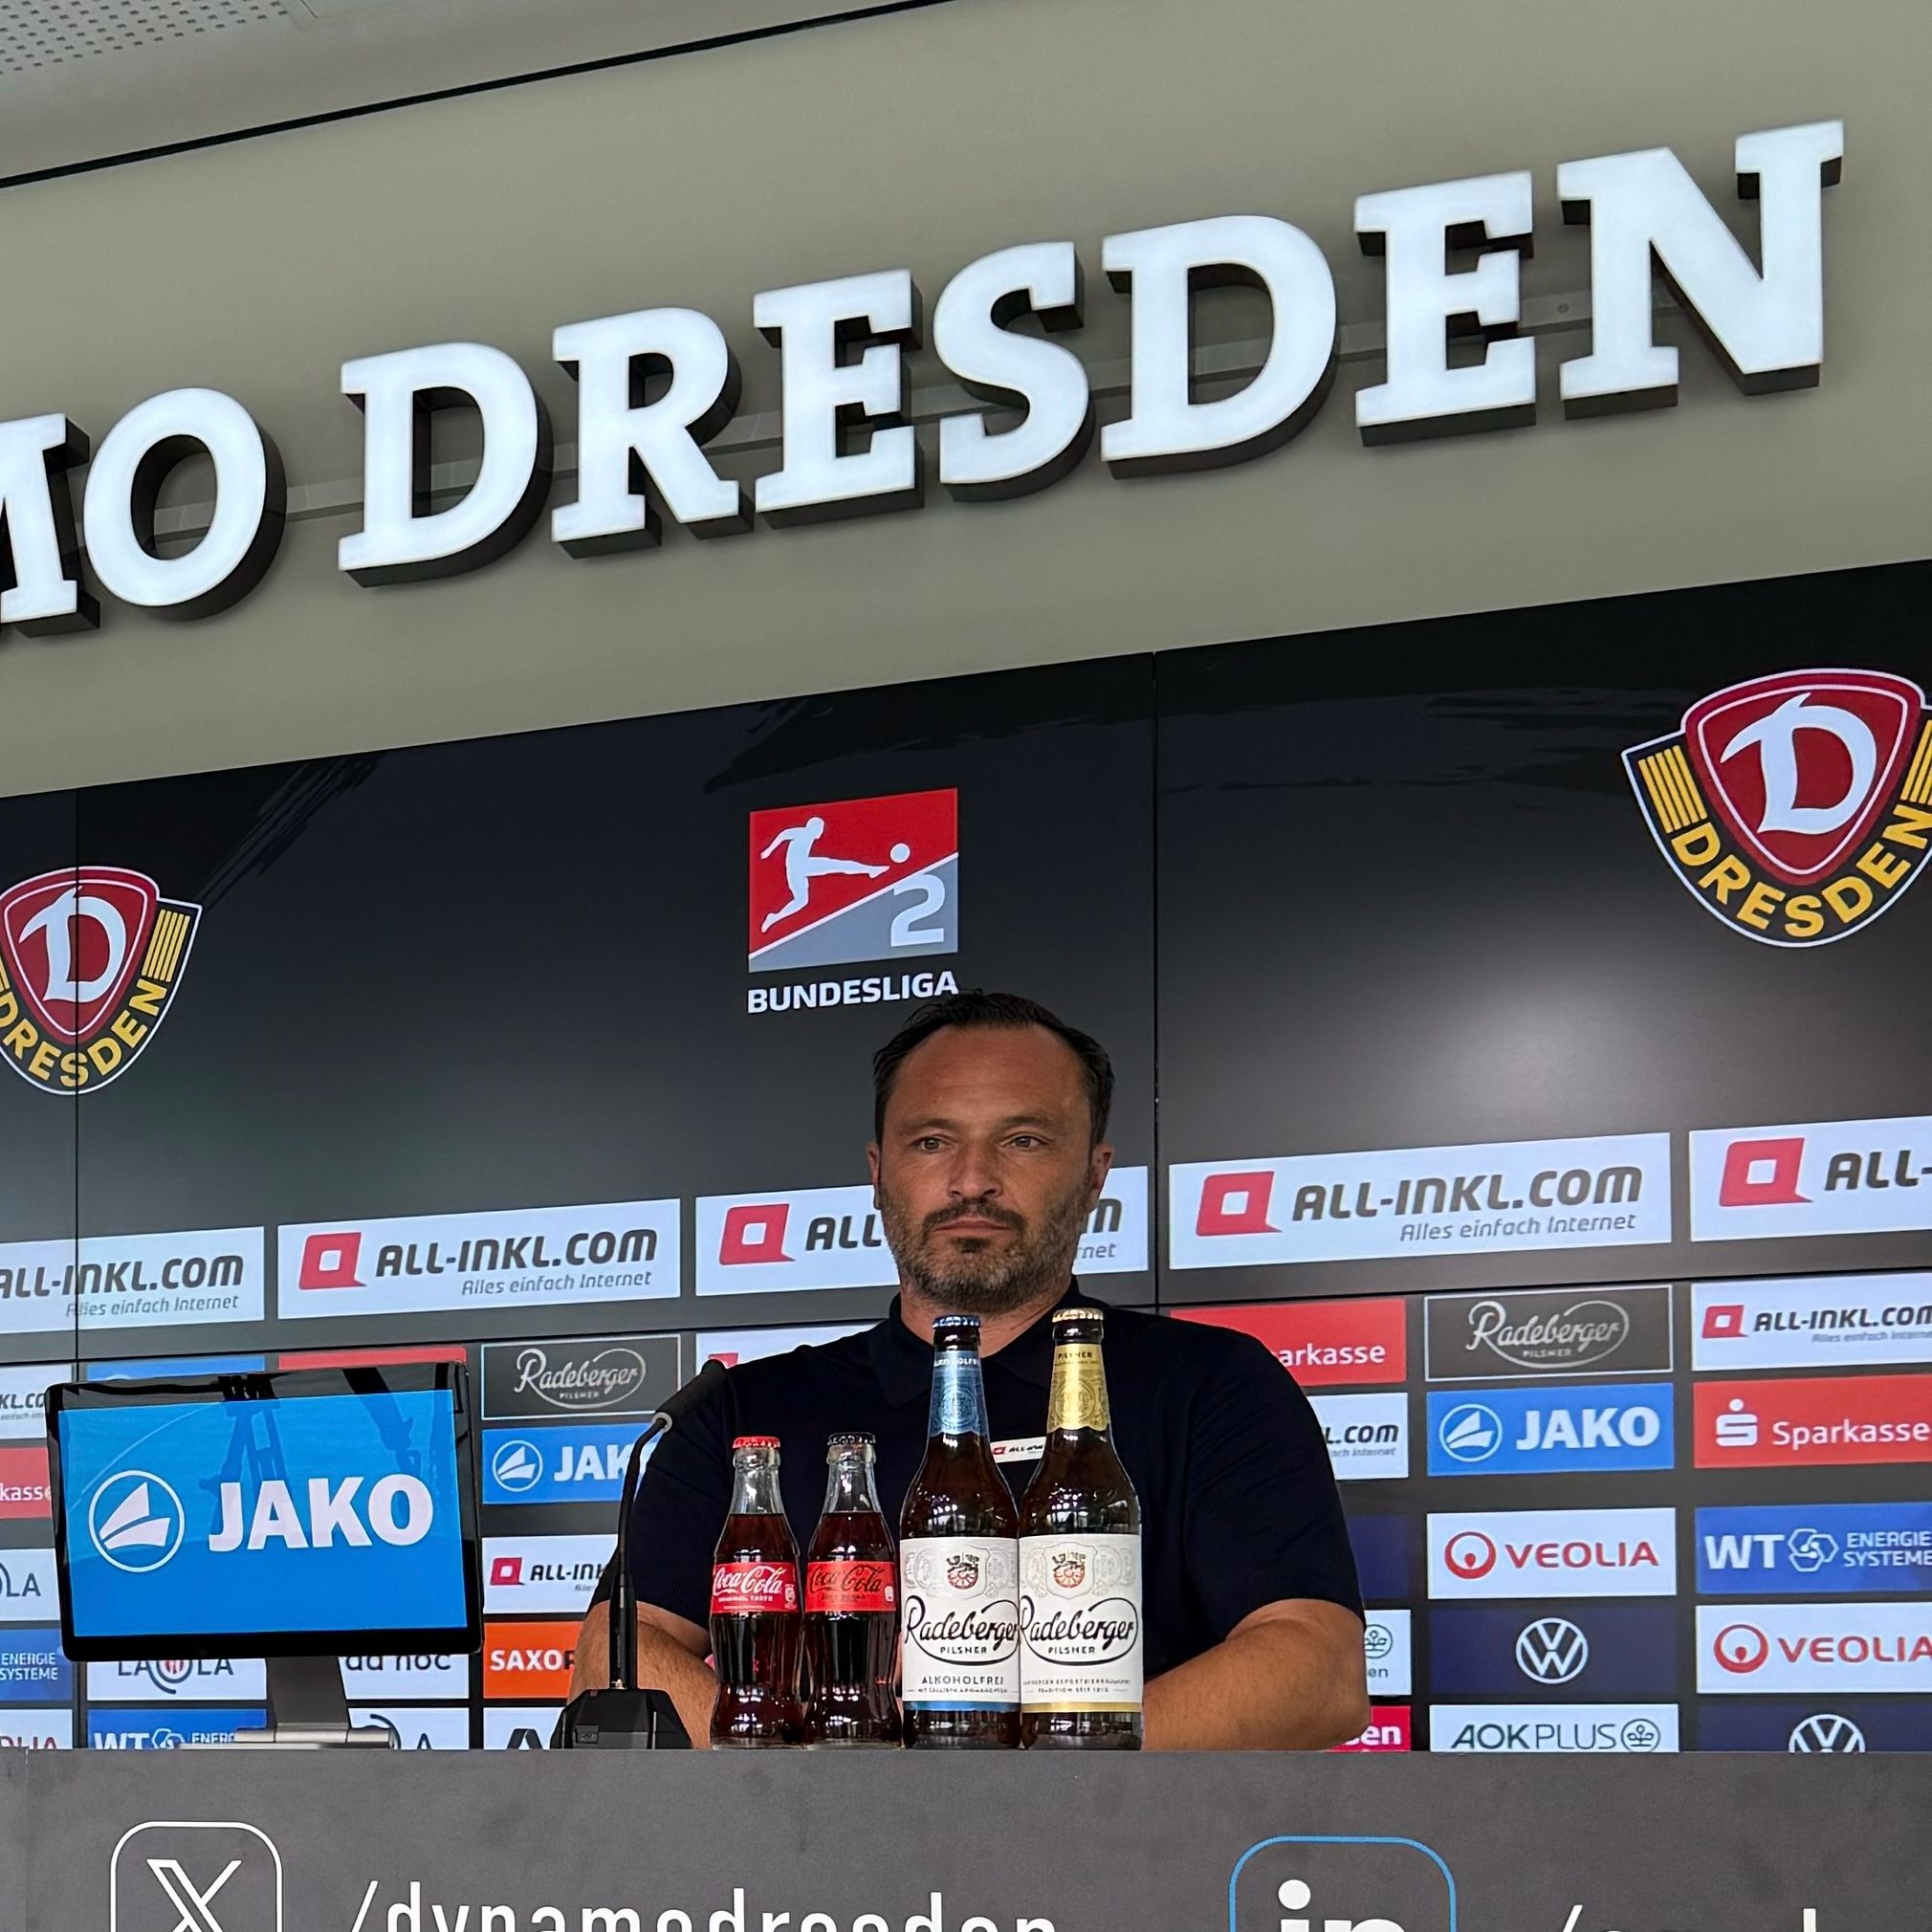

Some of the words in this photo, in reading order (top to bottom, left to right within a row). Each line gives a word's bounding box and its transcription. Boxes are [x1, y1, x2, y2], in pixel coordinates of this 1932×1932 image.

[338, 121, 1844, 572] DRESDEN
[1670, 804, 1932, 938] DRESDEN
[890, 873, 946, 948] 2
[747, 970, 959, 1015] BUNDESLIGA
[1291, 1165, 1643, 1222] ALL-INKL.COM
[1400, 1223, 1453, 1242] Alles
[1460, 1217, 1540, 1240] einfach
[1546, 1214, 1636, 1235] Internet
[374, 1228, 658, 1278] ALL-INKL.COM
[461, 1280, 505, 1297] Alles
[509, 1275, 575, 1294] einfach
[579, 1271, 652, 1288] Internet
[111, 1296, 170, 1315] einfach
[174, 1295, 239, 1312] Internet
[1466, 1301, 1622, 1353] Radeberger
[1279, 1343, 1386, 1368] arkasse
[515, 1349, 641, 1395] Radeberger
[1516, 1406, 1660, 1451] JAKO
[1772, 1418, 1930, 1451] Sparkasse
[209, 1473, 433, 1552] JAKO
[1504, 1541, 1659, 1569] VEOLIA
[1704, 1533, 1785, 1570] WT
[1847, 1530, 1932, 1548] ENERGIE
[1843, 1550, 1932, 1568] SYSTEME
[905, 1594, 1019, 1652] Radeberger
[1, 1652, 55, 1665] ENERGIE
[940, 1645, 988, 1655] PILSNER
[1048, 1645, 1096, 1655] PILSNER
[1777, 1636, 1932, 1663] VEOLIA
[0, 1666, 58, 1680] SYSTEME
[921, 1675, 1004, 1685] ALKOHOLFREI
[1346, 1725, 1401, 1745] en
